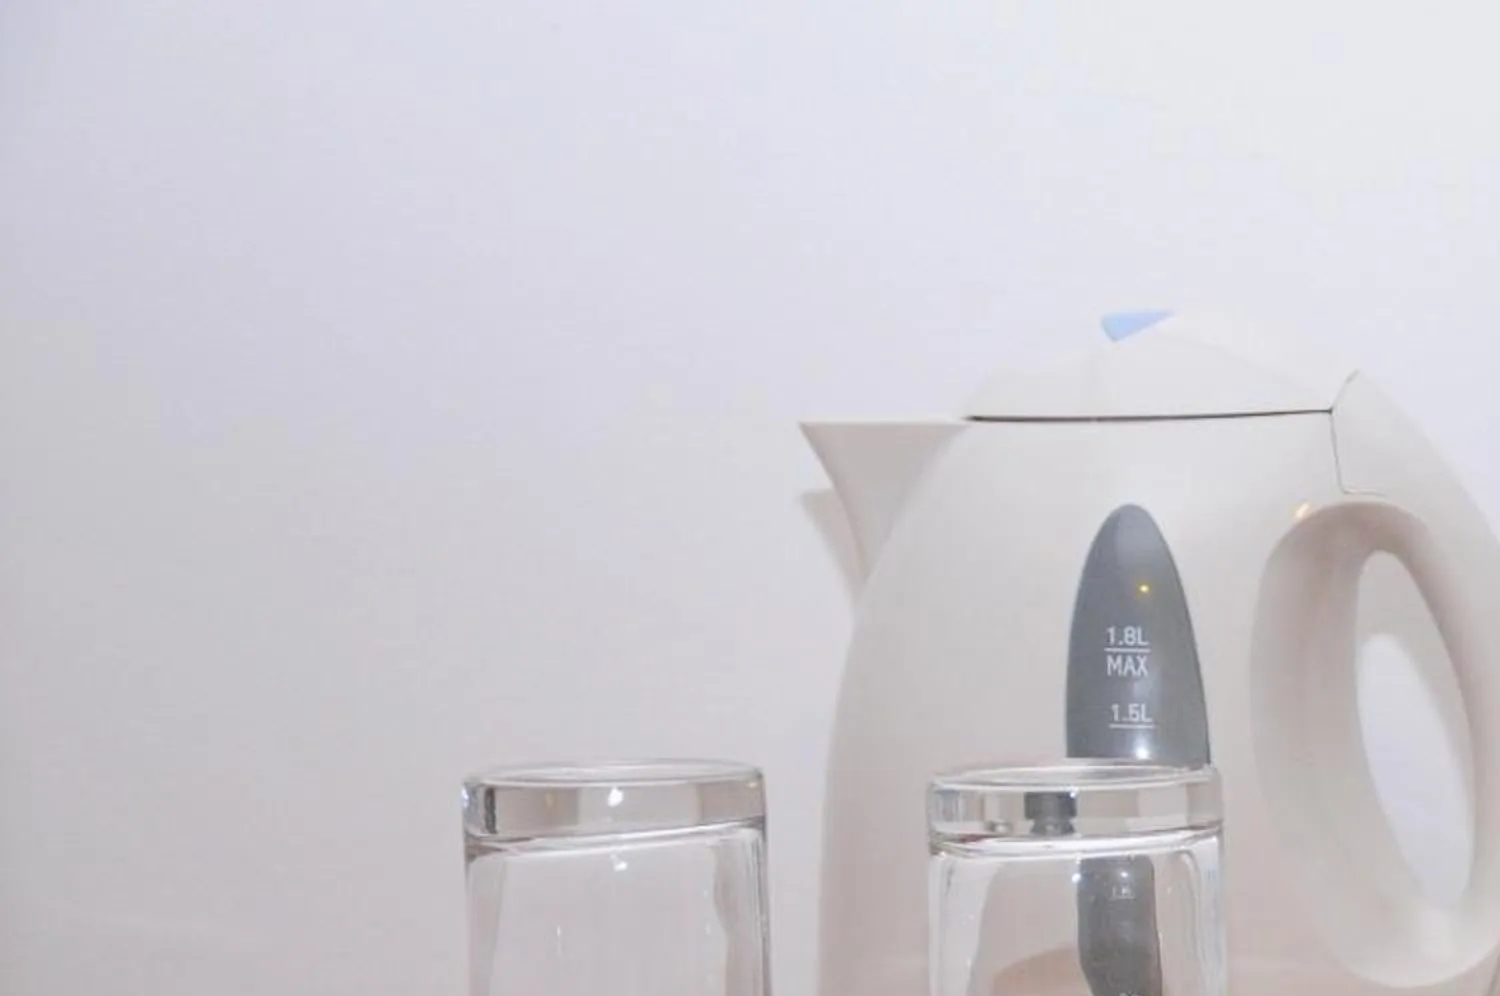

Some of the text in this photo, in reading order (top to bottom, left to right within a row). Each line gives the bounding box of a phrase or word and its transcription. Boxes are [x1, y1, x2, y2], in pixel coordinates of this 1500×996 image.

[1106, 626, 1149, 646] 1.8L
[1106, 655, 1149, 677] MAX
[1111, 704, 1153, 722] 1.5L
